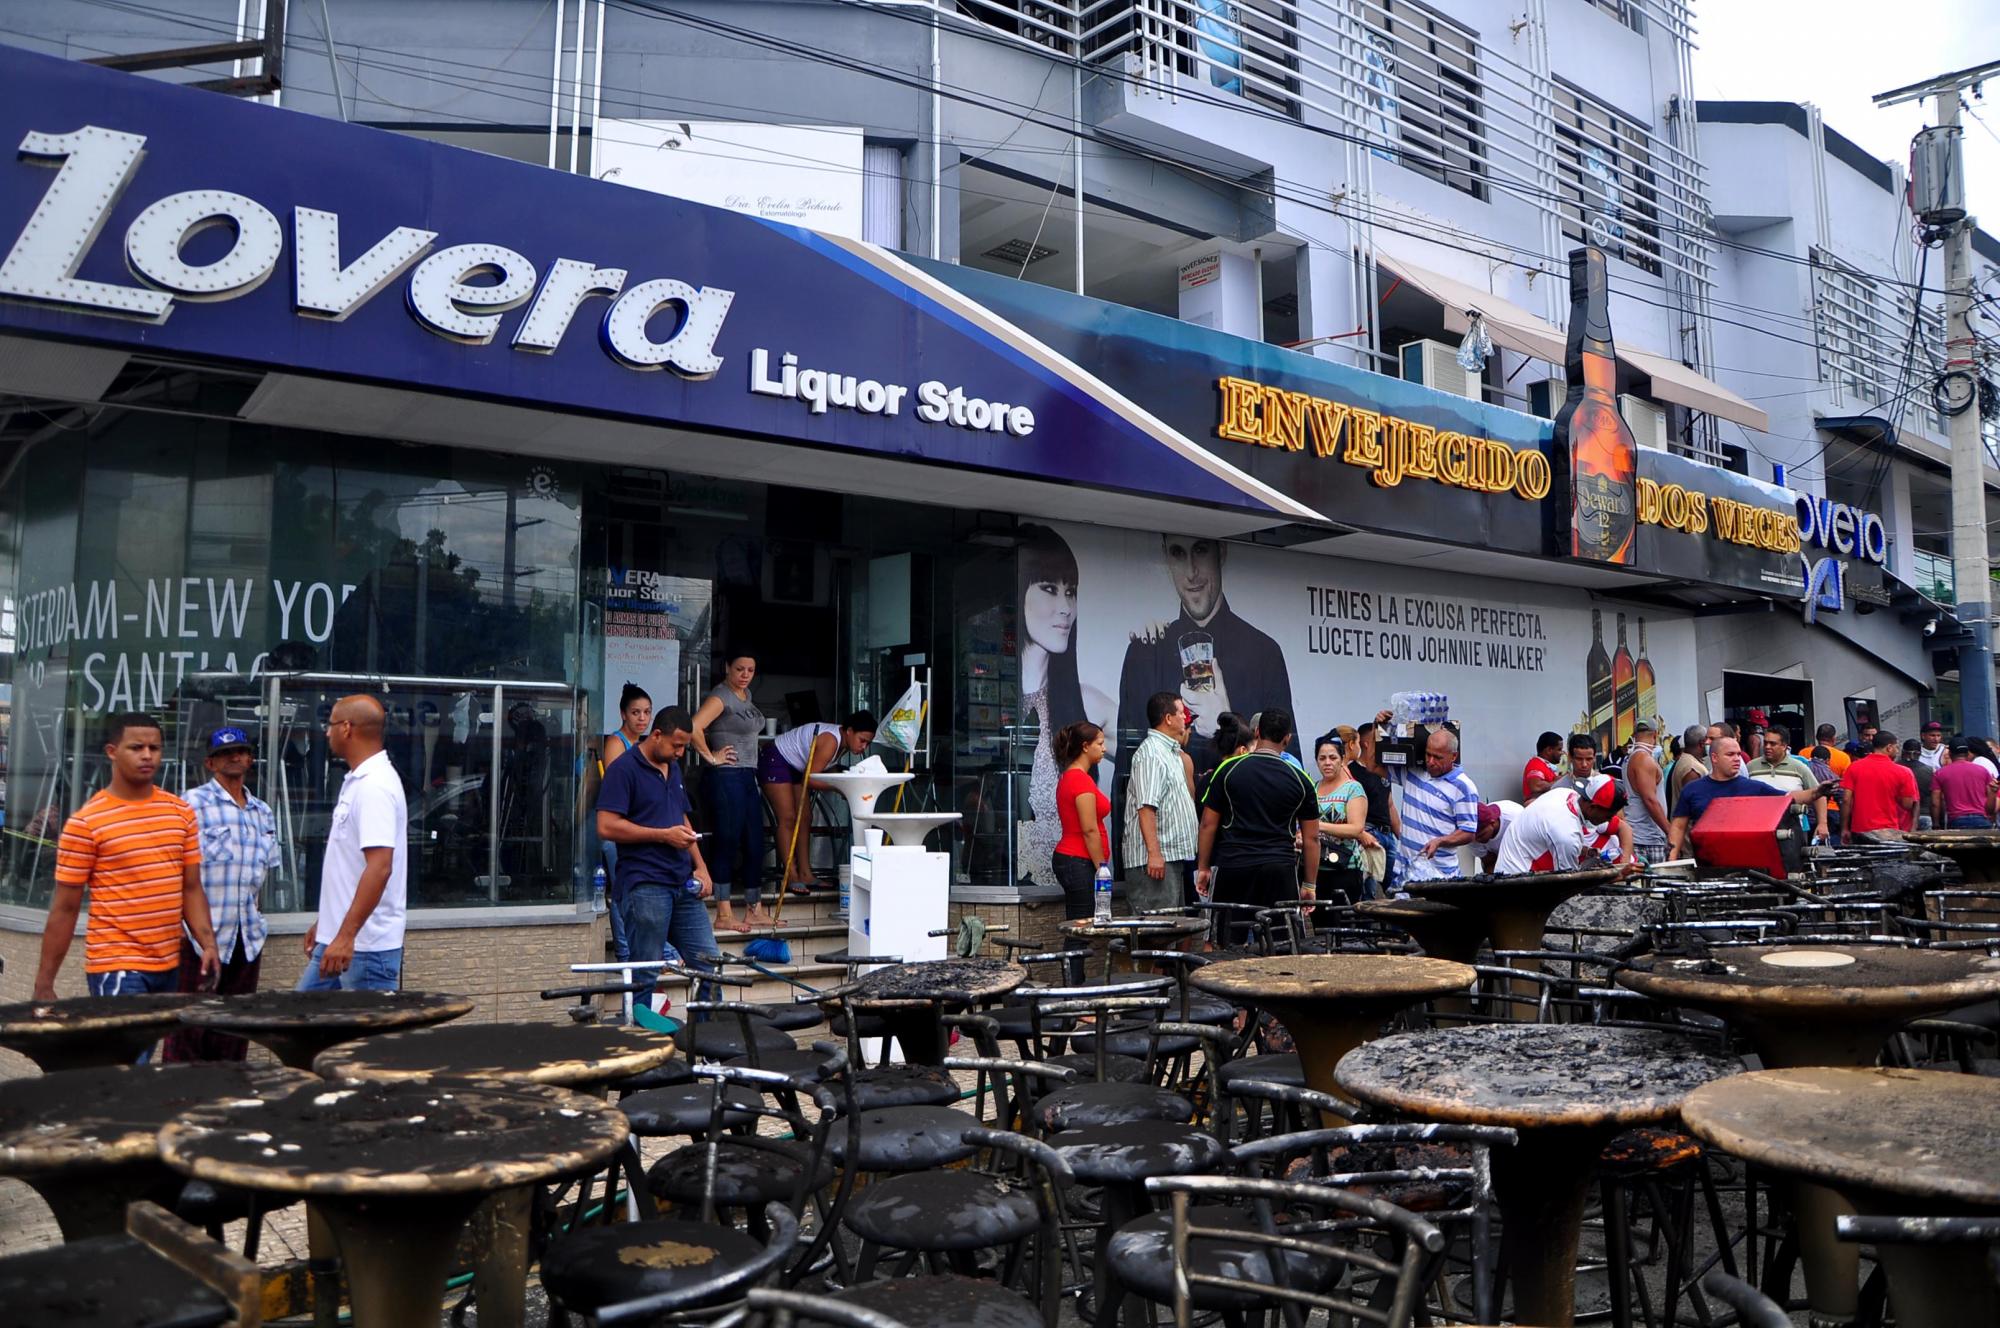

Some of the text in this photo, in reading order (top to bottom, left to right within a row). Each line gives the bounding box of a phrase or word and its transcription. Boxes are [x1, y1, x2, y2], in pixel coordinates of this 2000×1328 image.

[751, 348, 1035, 436] Liquor Store
[1219, 376, 1551, 500] ENVEJECIDO
[1635, 477, 1800, 553] DOS VECES
[273, 578, 357, 642] YO
[1307, 586, 1547, 640] TIENES LA EXCUSA PERFECTA.
[1308, 618, 1374, 658] LÚCETE
[1380, 632, 1411, 661] CON
[1417, 636, 1483, 667] JOHNNIE
